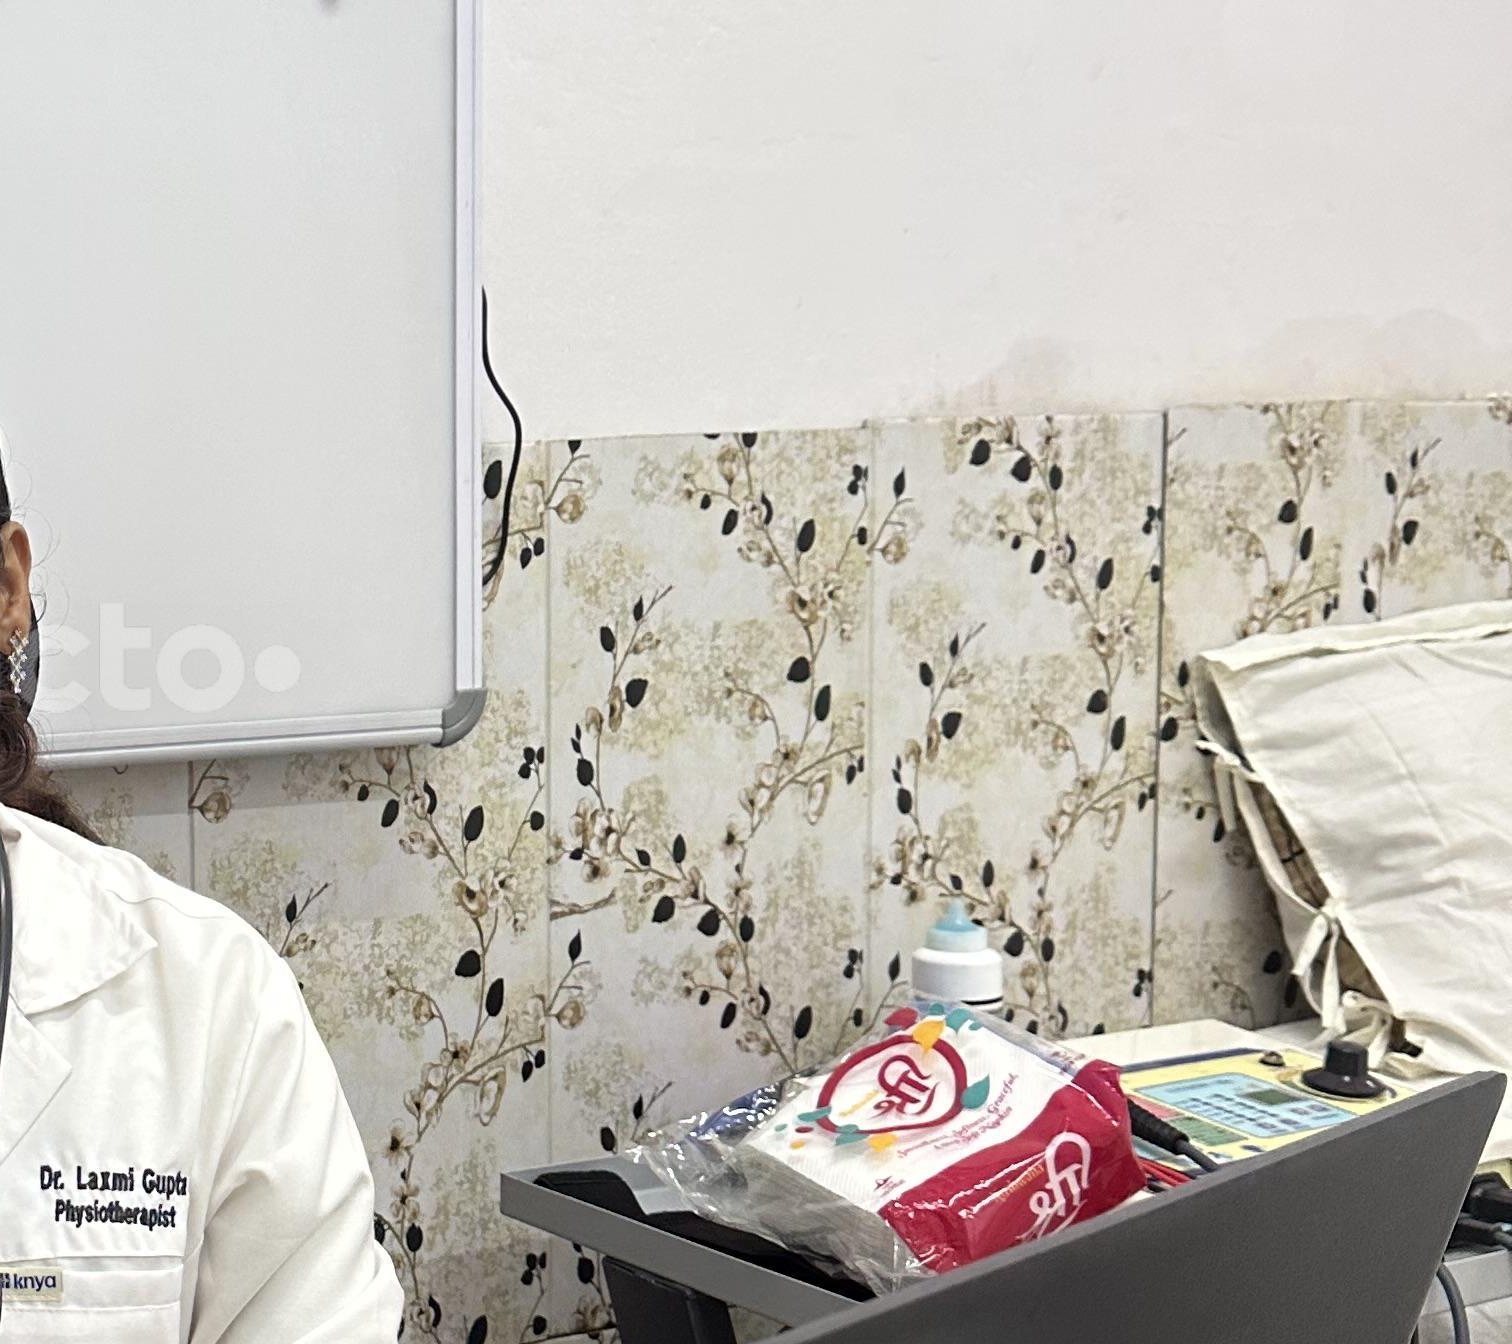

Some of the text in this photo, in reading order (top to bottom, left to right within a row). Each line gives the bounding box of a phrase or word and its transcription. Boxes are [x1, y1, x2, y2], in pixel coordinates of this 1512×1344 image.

[40, 1165, 64, 1190] Dr.
[77, 1166, 134, 1192] Laxmi
[55, 1199, 176, 1231] Physiotherapist
[14, 1273, 56, 1292] knya
